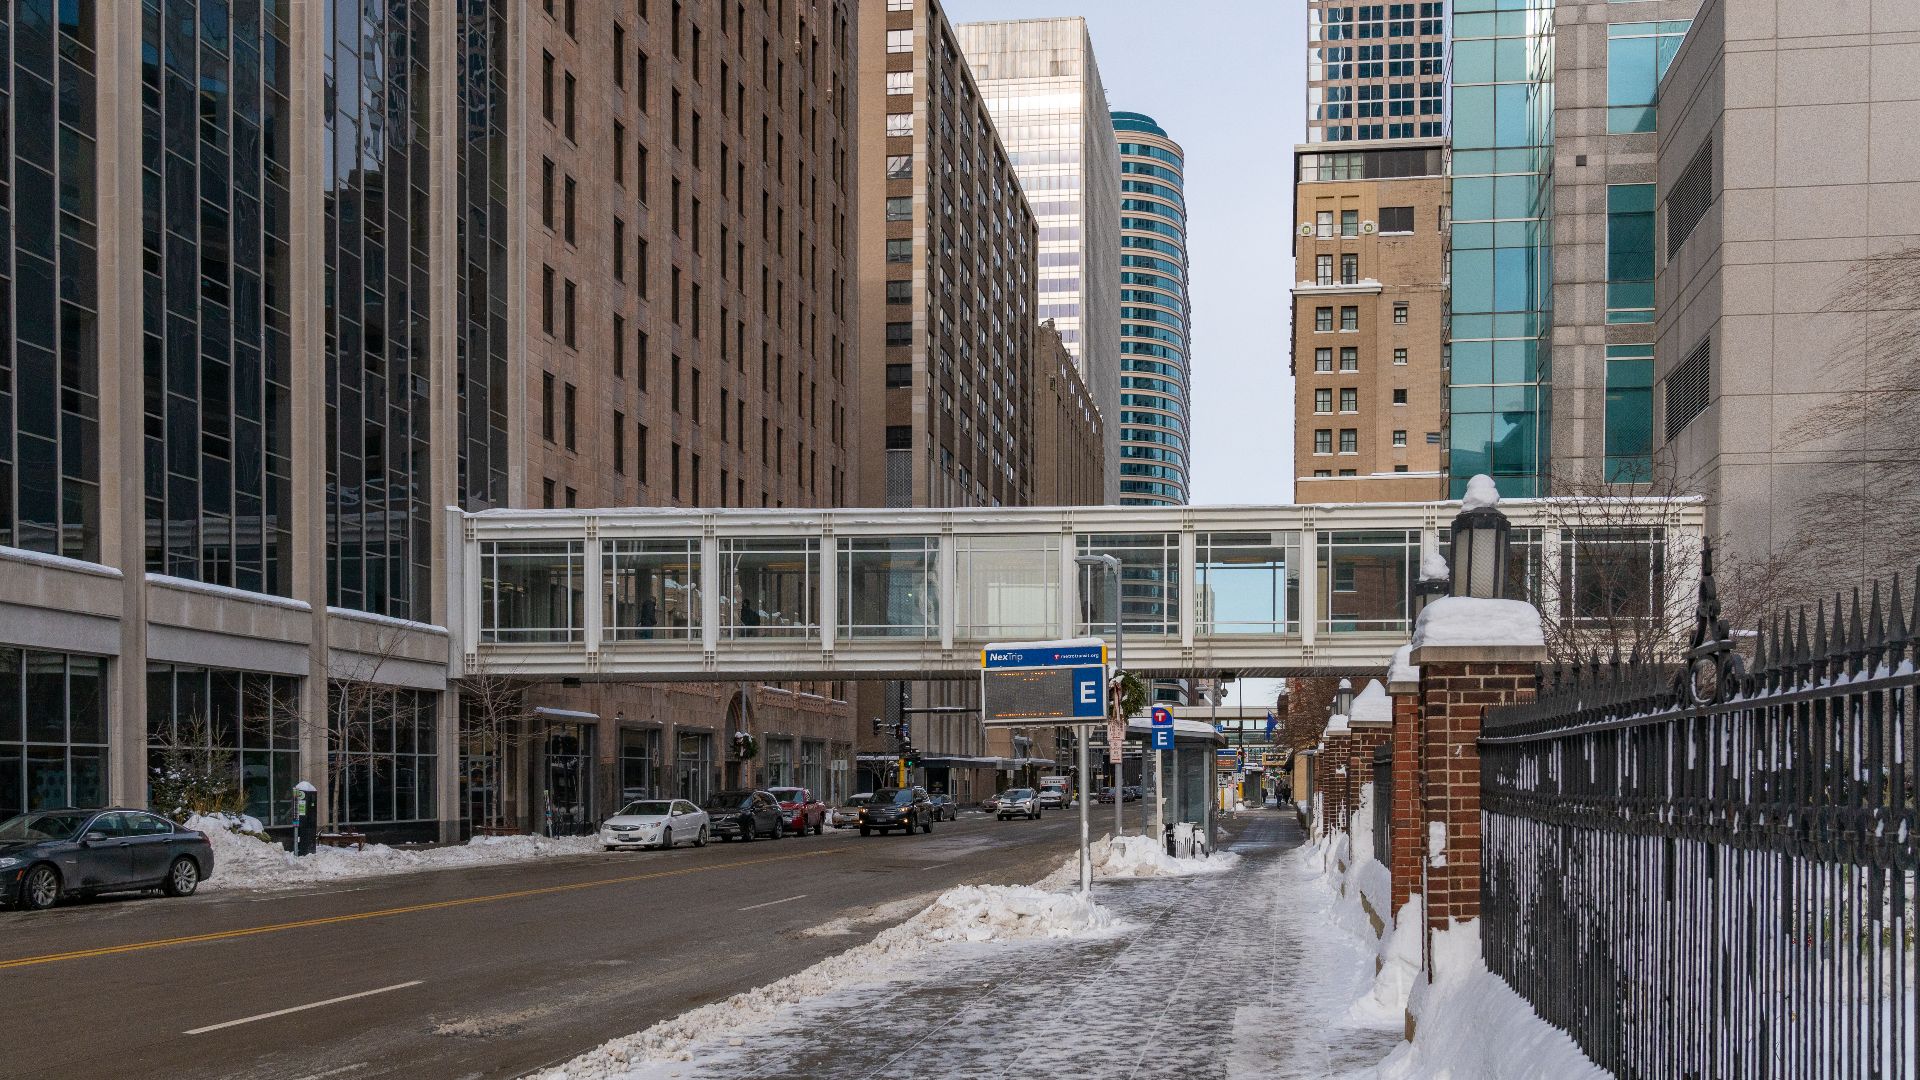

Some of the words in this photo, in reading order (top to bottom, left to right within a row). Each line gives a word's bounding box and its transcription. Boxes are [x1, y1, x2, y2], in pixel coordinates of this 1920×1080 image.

[990, 652, 1023, 662] NexTrip
[1080, 681, 1097, 704] E
[1157, 731, 1168, 746] E
